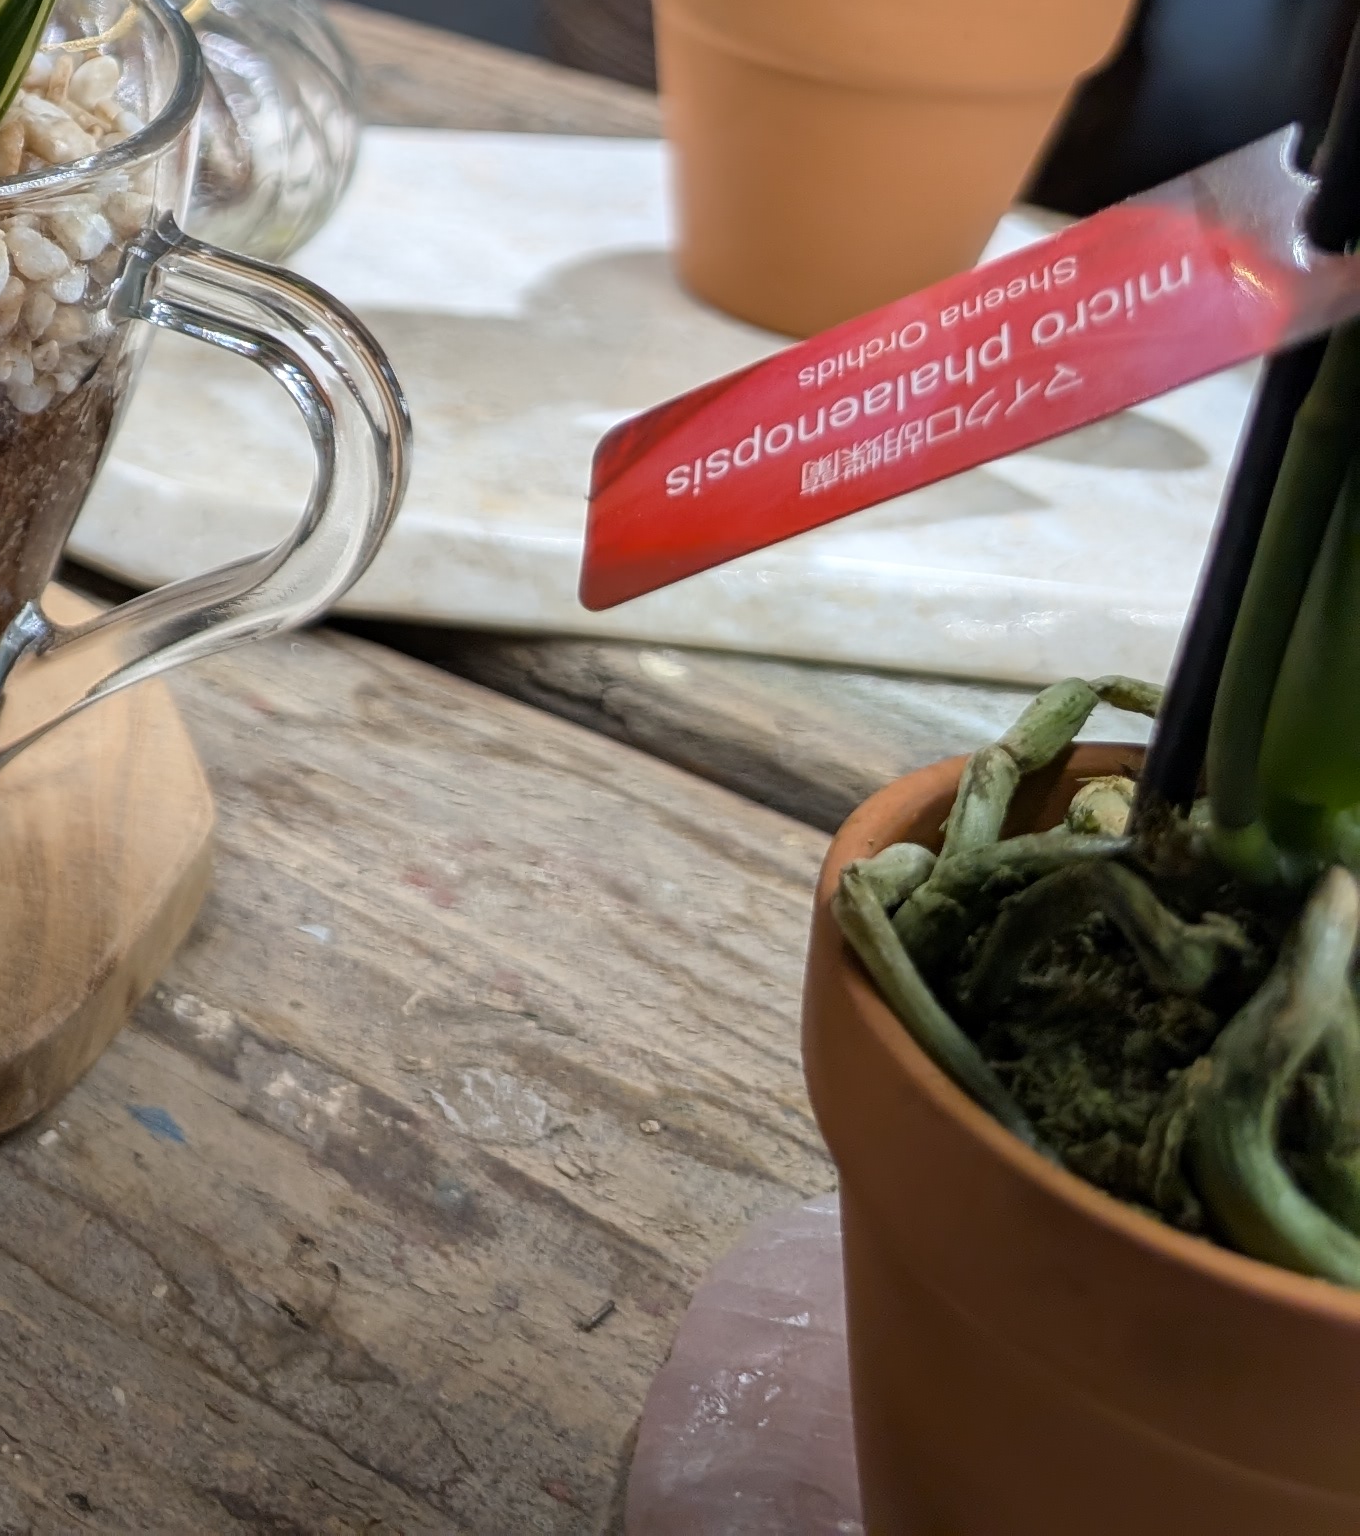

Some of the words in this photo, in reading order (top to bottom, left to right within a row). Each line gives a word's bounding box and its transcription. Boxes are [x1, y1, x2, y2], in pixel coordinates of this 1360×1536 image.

[939, 255, 1079, 329] Sheena
[1032, 253, 1194, 349] micro
[797, 321, 928, 389] Orchids
[664, 327, 1013, 498] phalaenopsis
[798, 366, 1084, 497] マイクロ胡蝶蘭
